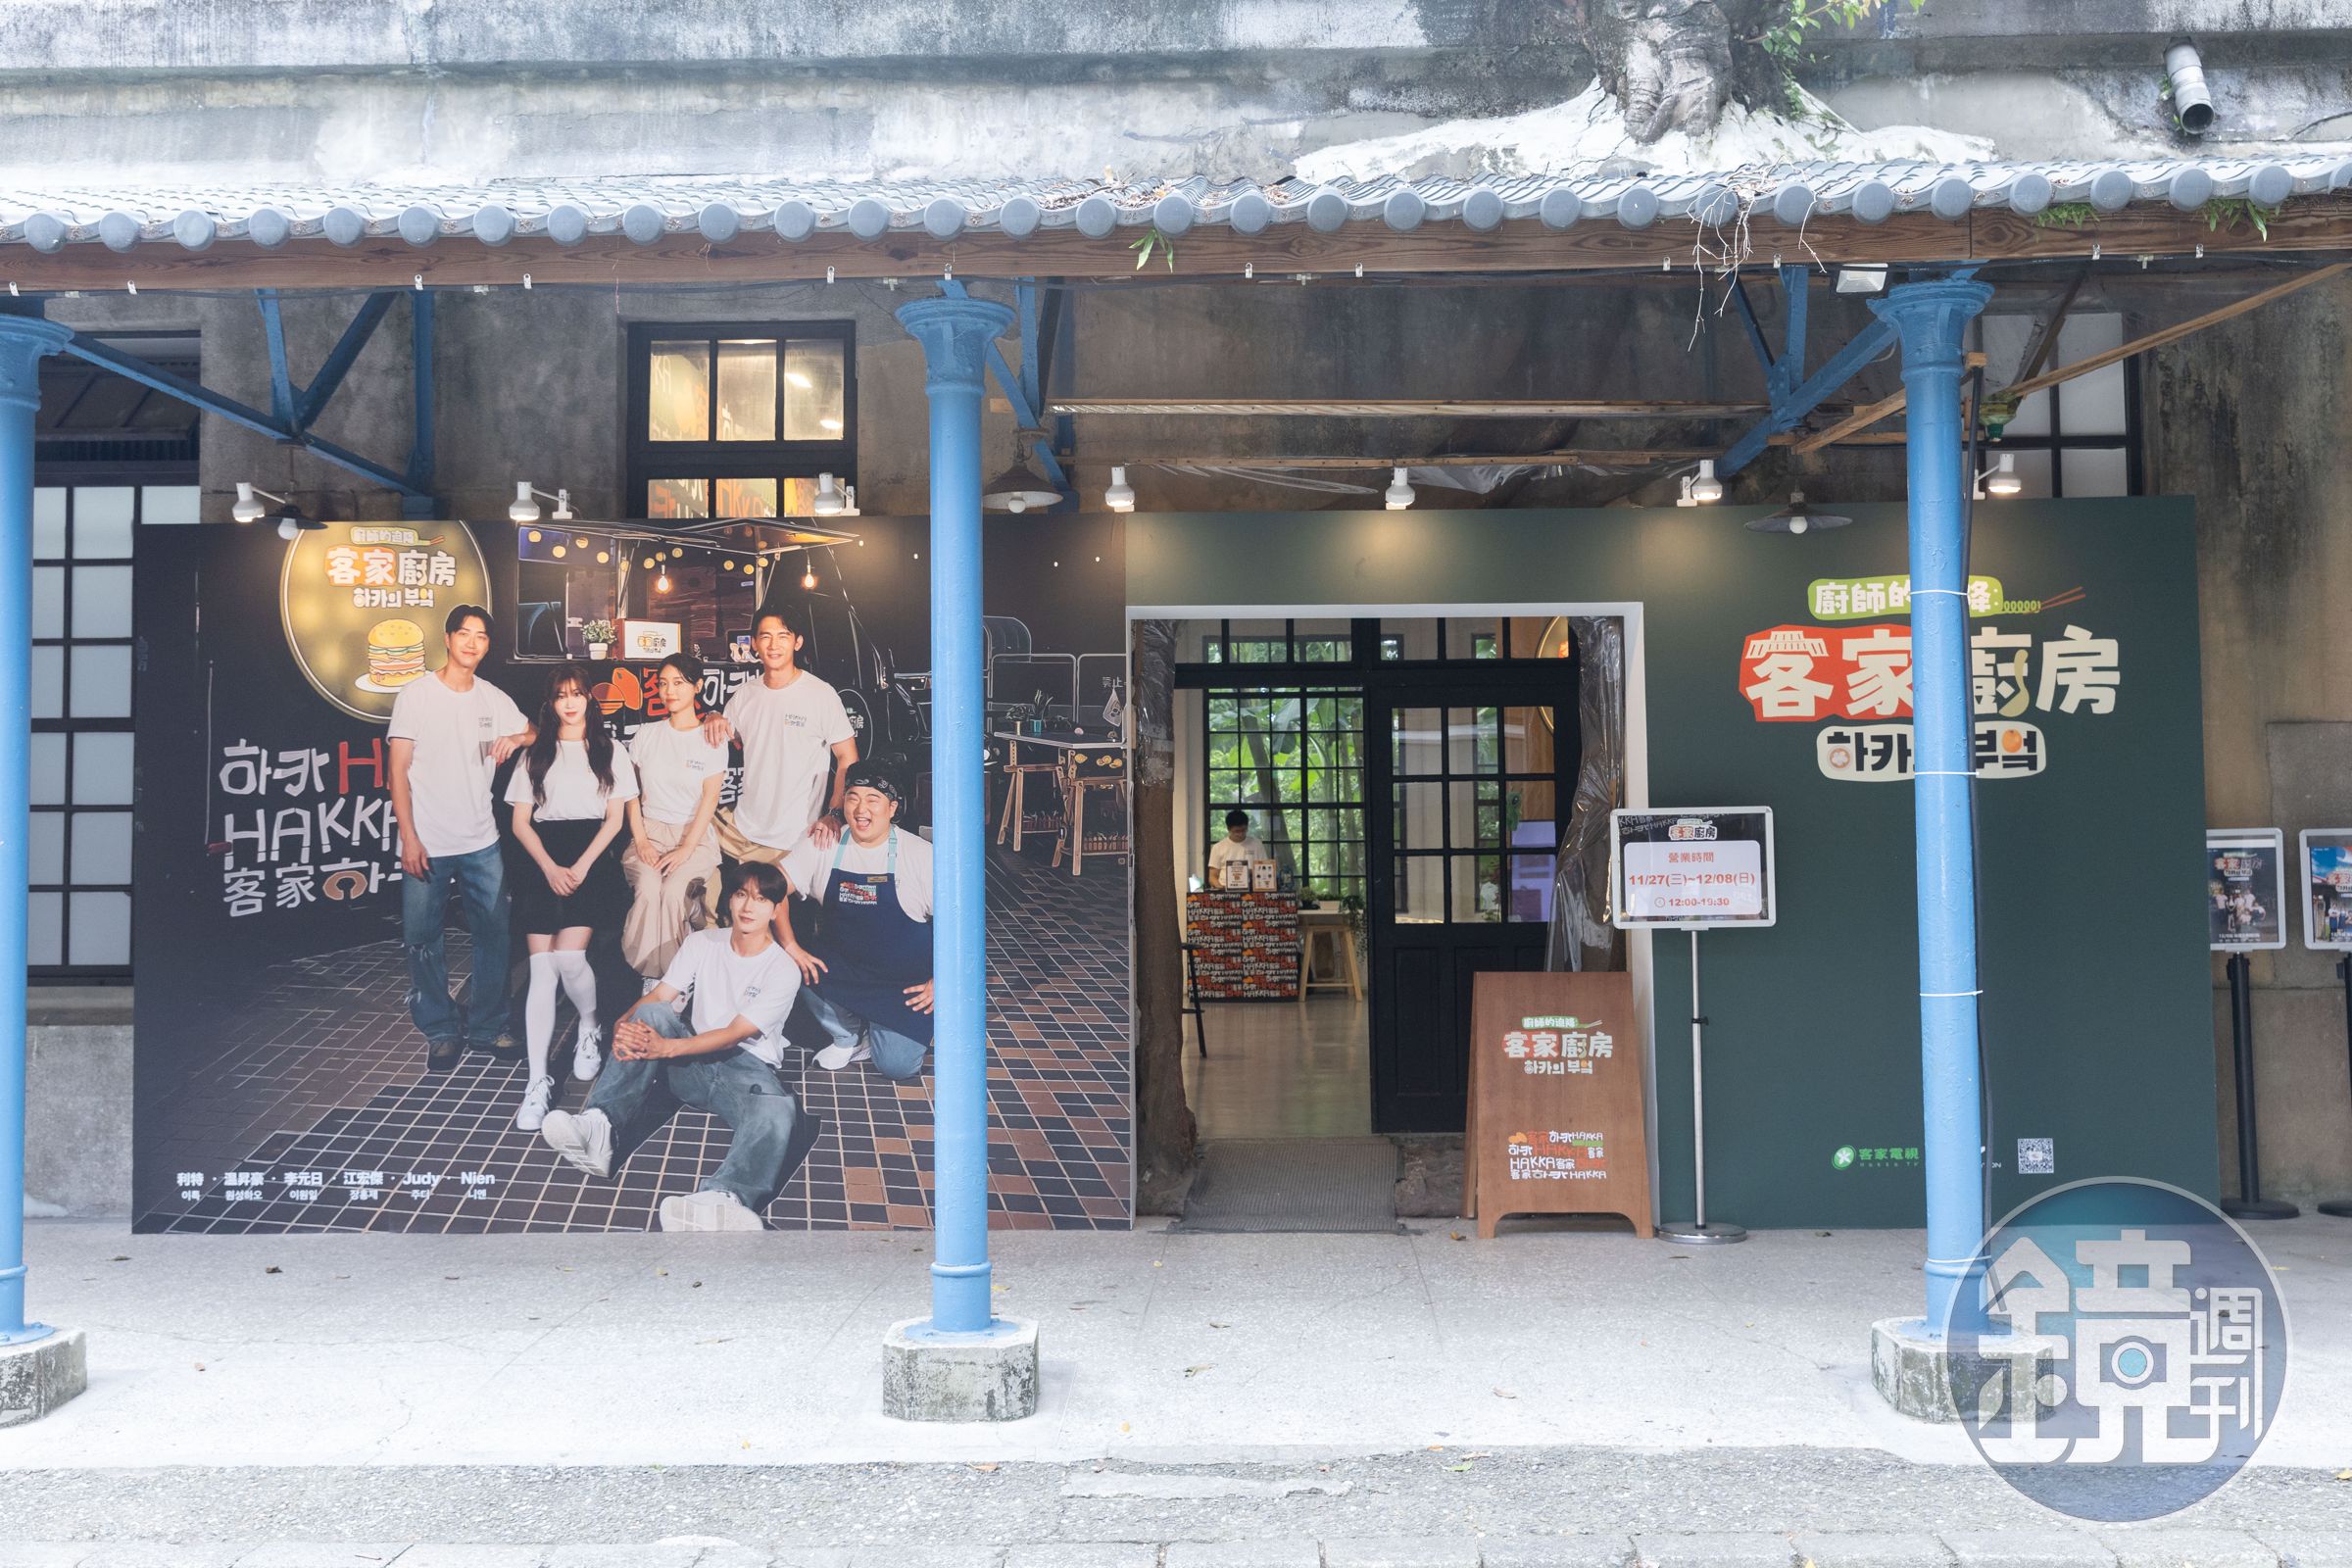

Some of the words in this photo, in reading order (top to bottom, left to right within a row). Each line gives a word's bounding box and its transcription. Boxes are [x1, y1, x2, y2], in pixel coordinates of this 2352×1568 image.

[328, 548, 456, 586] 客家廚房
[354, 588, 402, 608] 하카의
[1815, 580, 1990, 614] 廚師的降
[1745, 624, 2121, 718] 客家廚房
[220, 739, 330, 797] 하카
[1668, 852, 1714, 863] 營業時間
[1630, 872, 1755, 886] 11/27(三)~12/08(日)
[223, 862, 317, 917] 客家
[1669, 898, 1730, 906] 12:00-19:30
[1504, 1031, 1613, 1058] 客家廚房
[1524, 1060, 1565, 1075] 하카의
[1510, 1155, 1556, 1170] HAKKA
[1859, 1148, 1920, 1160] 客家電視
[402, 1172, 440, 1187] Judy
[461, 1171, 496, 1185] Nien
